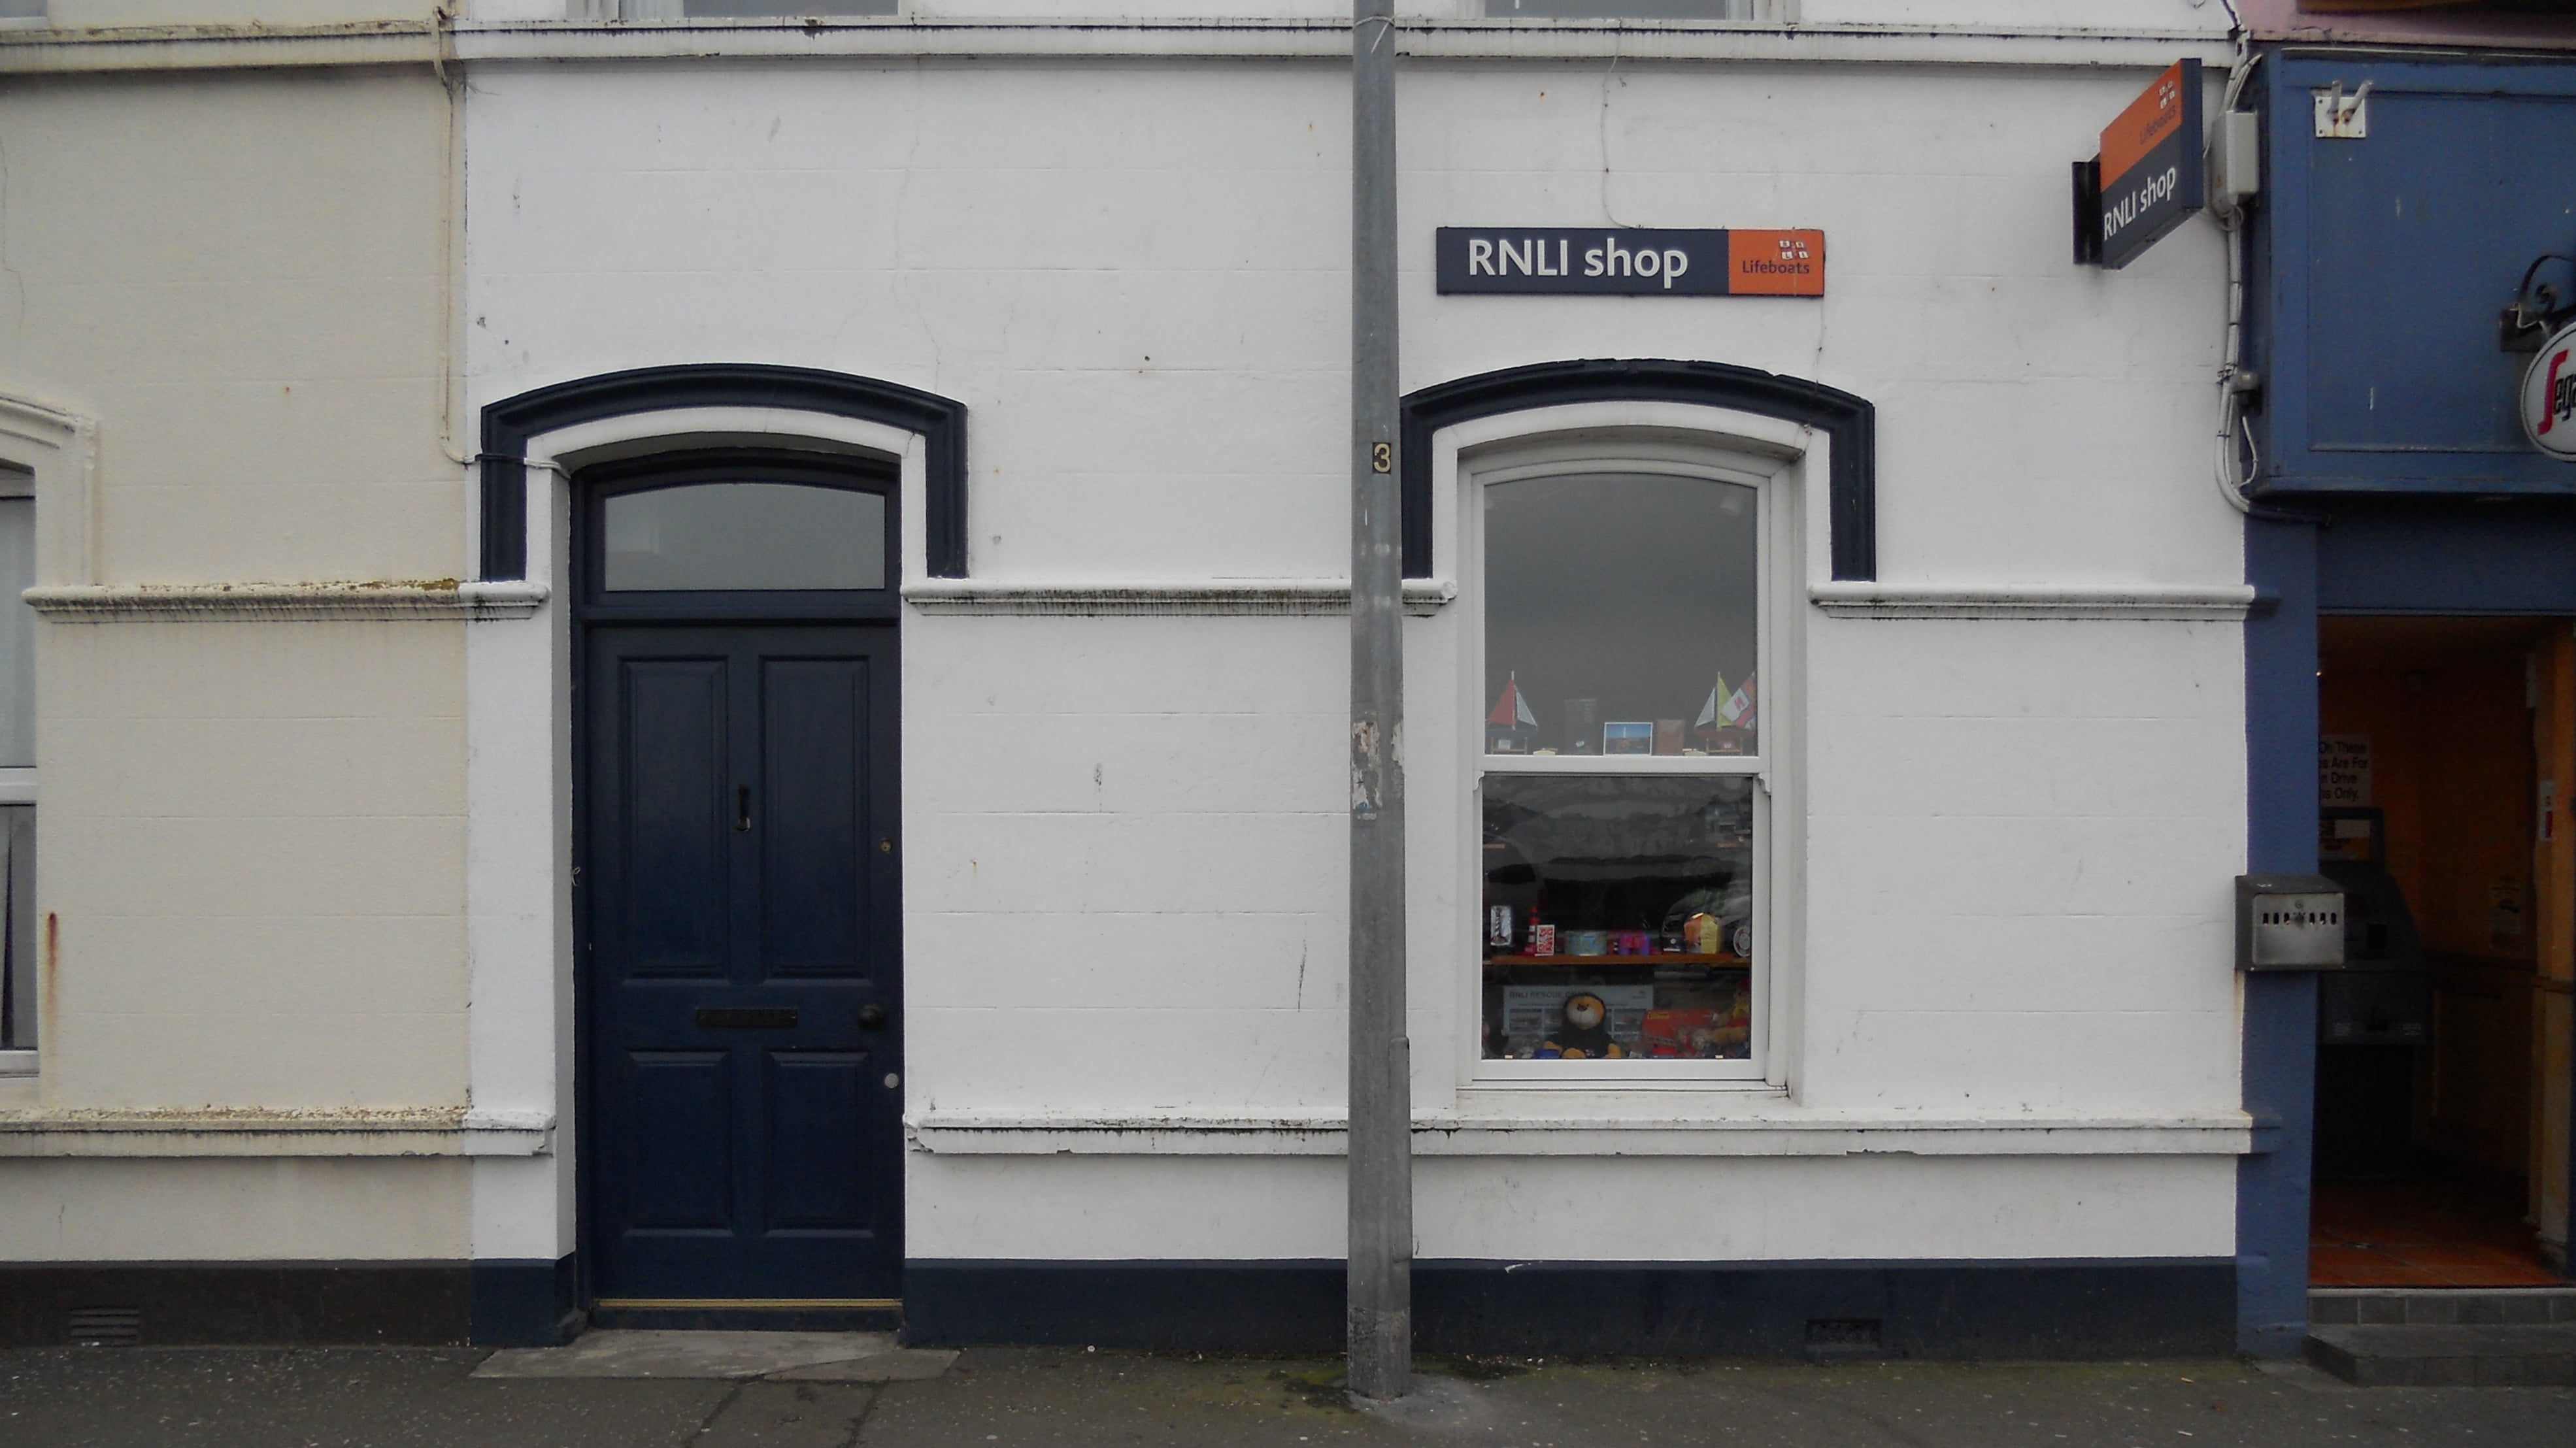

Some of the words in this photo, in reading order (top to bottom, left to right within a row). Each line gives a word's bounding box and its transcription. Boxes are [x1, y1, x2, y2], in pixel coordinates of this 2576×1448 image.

[2104, 191, 2136, 241] RNLI
[2140, 167, 2176, 212] shop
[1469, 239, 1568, 276] RNLI
[1584, 237, 1688, 289] shop
[1743, 260, 1810, 274] Lifeboats
[1373, 443, 1391, 472] 3
[2332, 757, 2349, 768] Are
[2352, 757, 2368, 768] For
[2331, 772, 2358, 783] Drive
